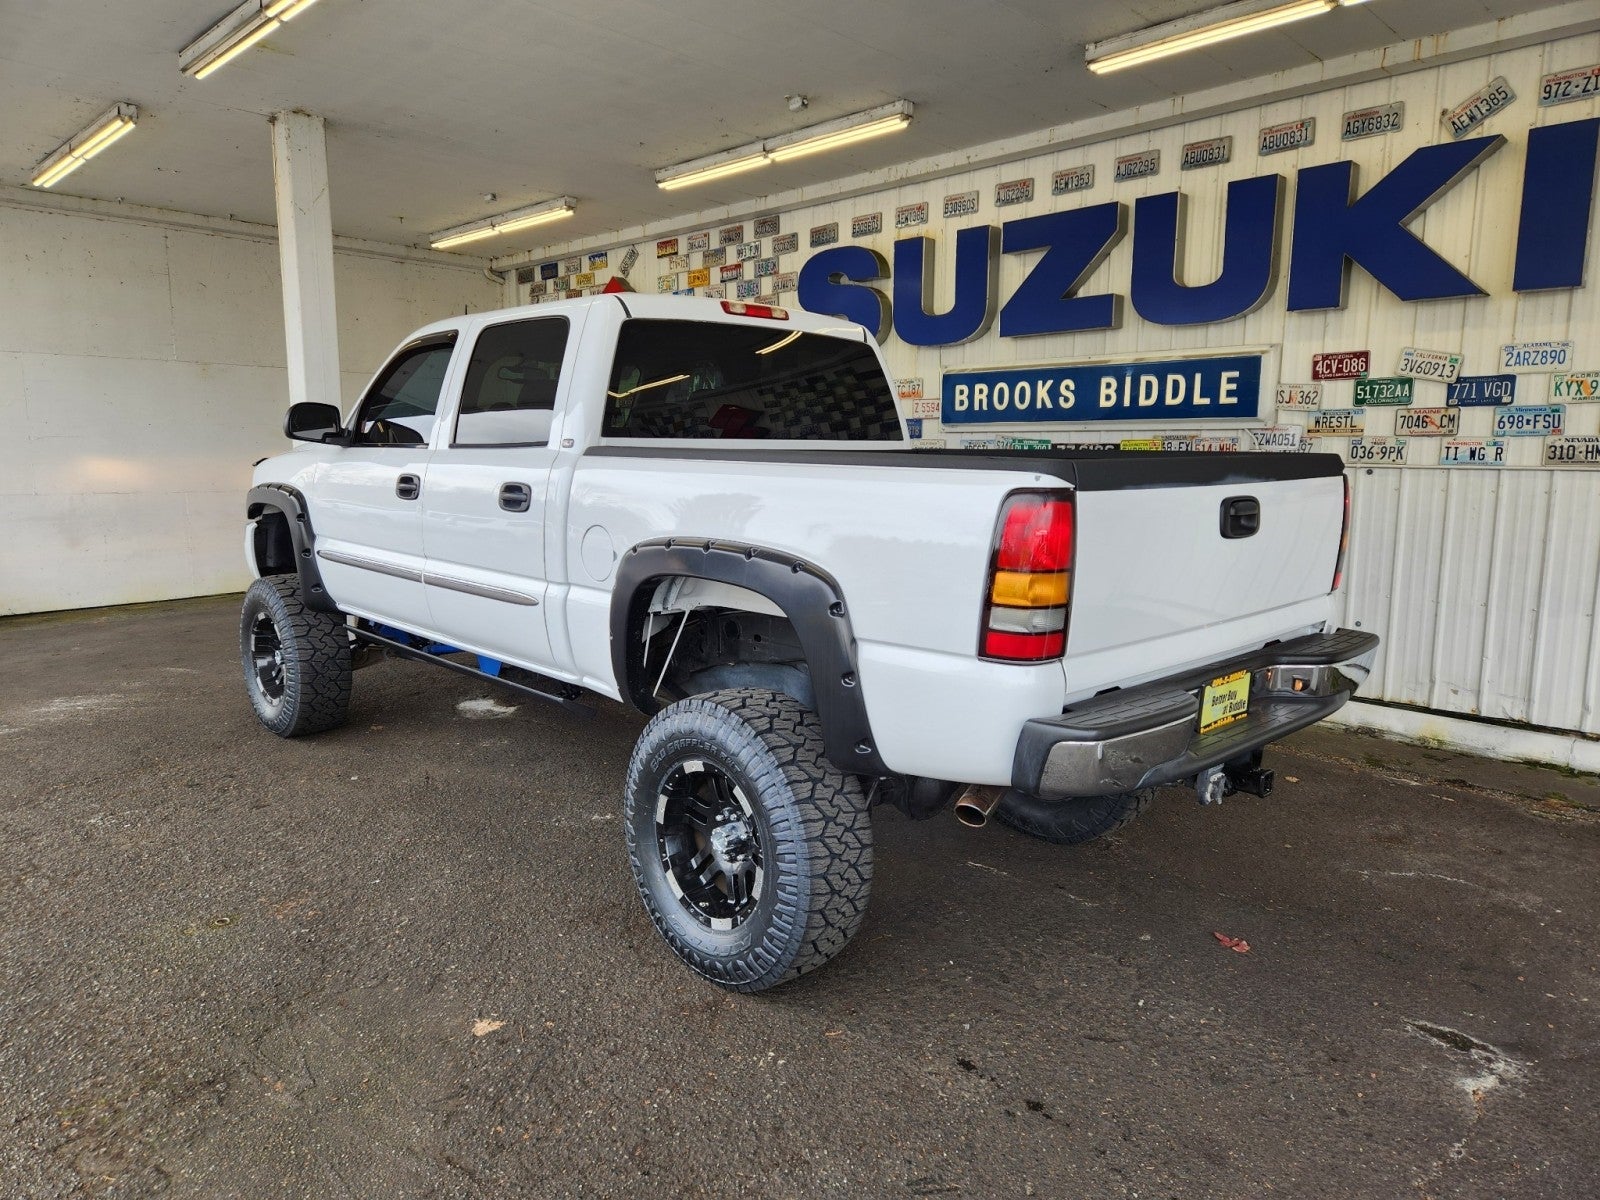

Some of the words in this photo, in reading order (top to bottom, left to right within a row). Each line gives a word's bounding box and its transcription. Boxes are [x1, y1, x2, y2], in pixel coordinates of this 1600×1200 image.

[1545, 72, 1588, 83] WASHINGTON
[1347, 110, 1380, 120] WASHINGTON
[1448, 95, 1482, 121] WASHINGTON
[1450, 85, 1509, 134] AEW1385
[1344, 112, 1400, 136] AGY6832
[1261, 128, 1308, 151] ABU0831
[1184, 145, 1226, 165] ABU0831
[1115, 158, 1156, 180] AJG2295
[1054, 172, 1090, 192] AEW1353
[797, 118, 1600, 348] SUZUKI
[1416, 352, 1448, 361] CALIFORNIA
[1505, 349, 1566, 366] 2ARZ890
[1316, 357, 1366, 374] 4CV-086
[1400, 358, 1456, 378] 3V60913
[954, 378, 1076, 412] BROOKS
[1099, 370, 1240, 409] BIDDLE
[1357, 383, 1410, 399] 51732AA
[1452, 382, 1476, 399] 771
[1484, 381, 1511, 397] VGD
[1554, 380, 1584, 396] KYX
[1298, 390, 1319, 405] 362
[1314, 416, 1357, 429] WRESTL
[1400, 414, 1429, 429] 7046
[1440, 414, 1456, 428] CM
[1498, 414, 1525, 430] 698
[1533, 413, 1561, 429] FSU
[1351, 445, 1375, 460] 036
[1380, 445, 1405, 460] 9PK
[1211, 693, 1228, 707] Better
[1229, 700, 1247, 713] Biddle
[666, 738, 718, 755] GRAPPLER
